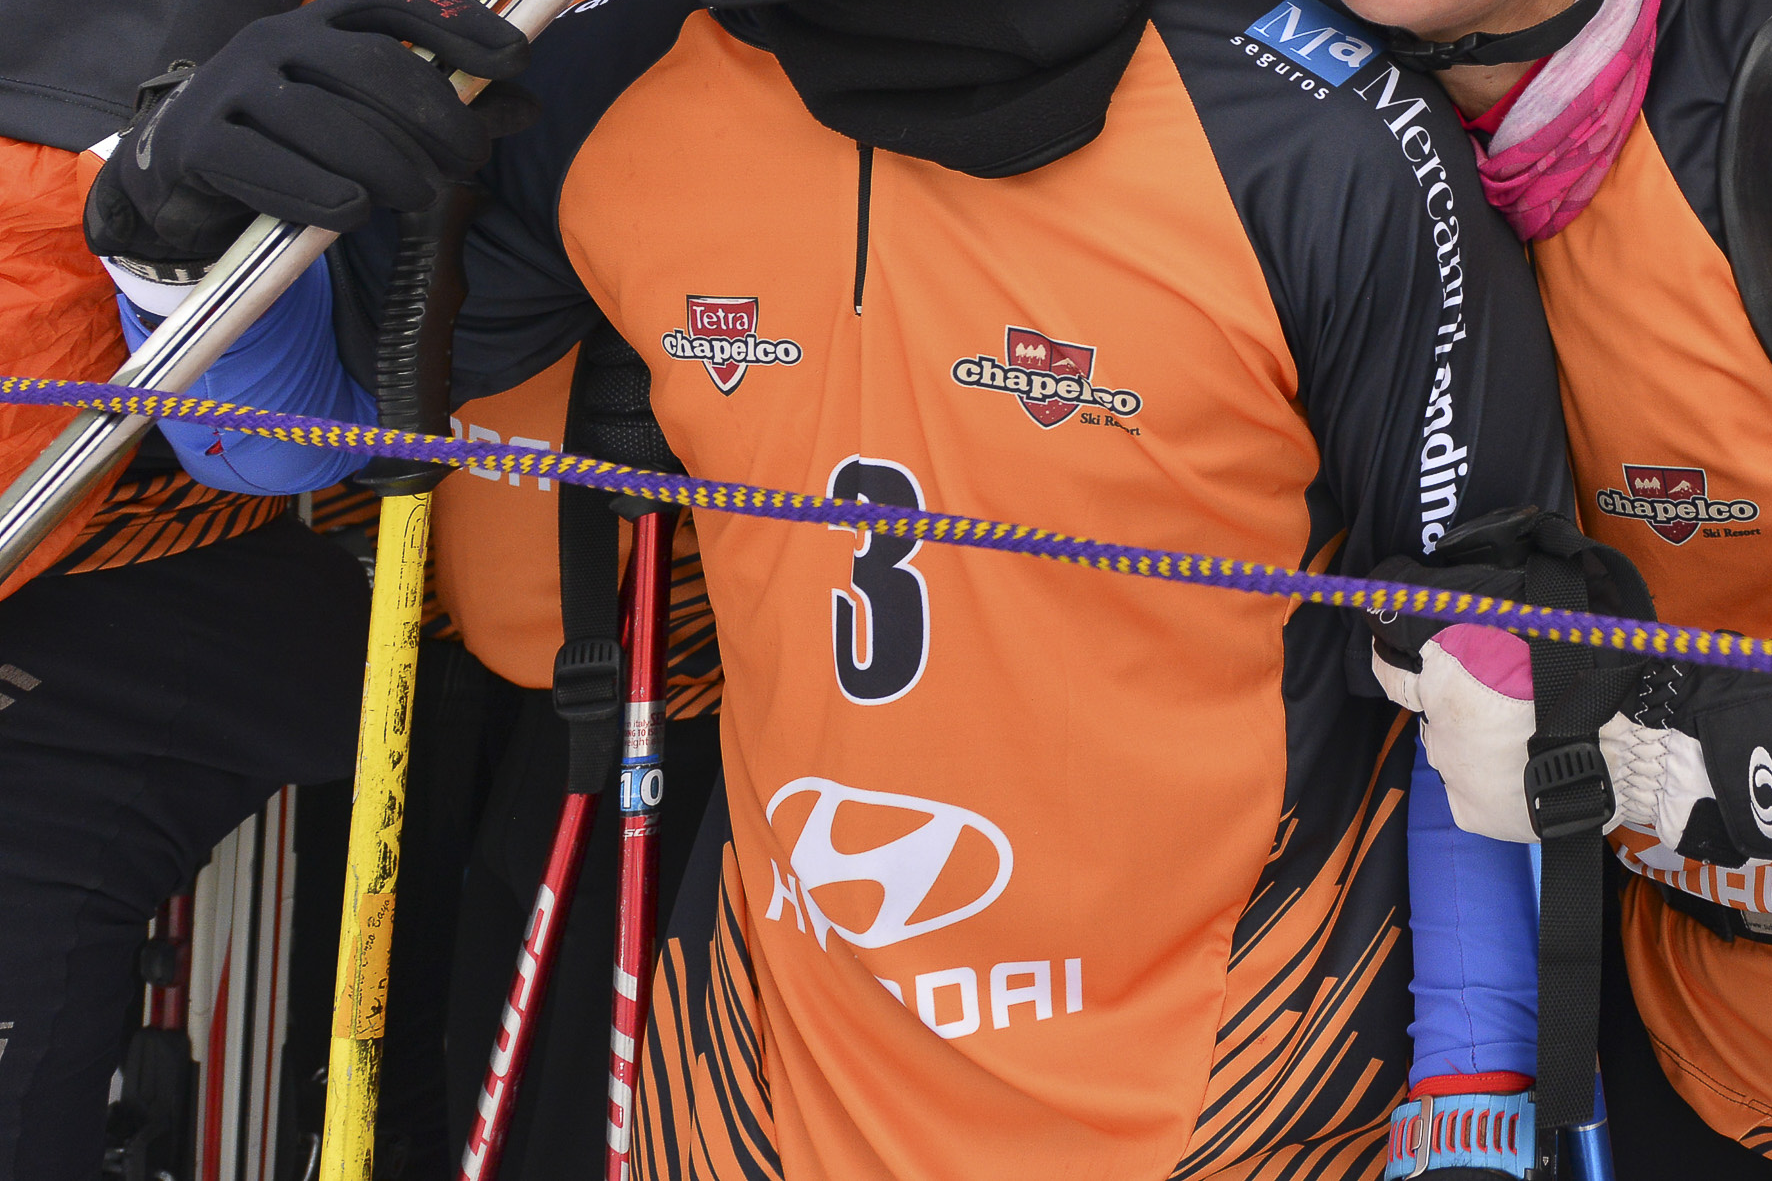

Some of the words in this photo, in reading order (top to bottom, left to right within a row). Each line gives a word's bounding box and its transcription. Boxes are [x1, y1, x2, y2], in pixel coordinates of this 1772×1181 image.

[1253, 1, 1373, 68] Ma
[1230, 34, 1330, 100] seguros
[692, 305, 750, 331] Tetra
[664, 332, 799, 365] chapelco
[955, 358, 1138, 415] chapelco
[1080, 413, 1101, 427] Ski
[1598, 491, 1757, 524] chapelco
[1702, 528, 1721, 539] Ski
[1724, 527, 1762, 538] Resort
[825, 453, 930, 707] 3
[620, 768, 664, 809] 10
